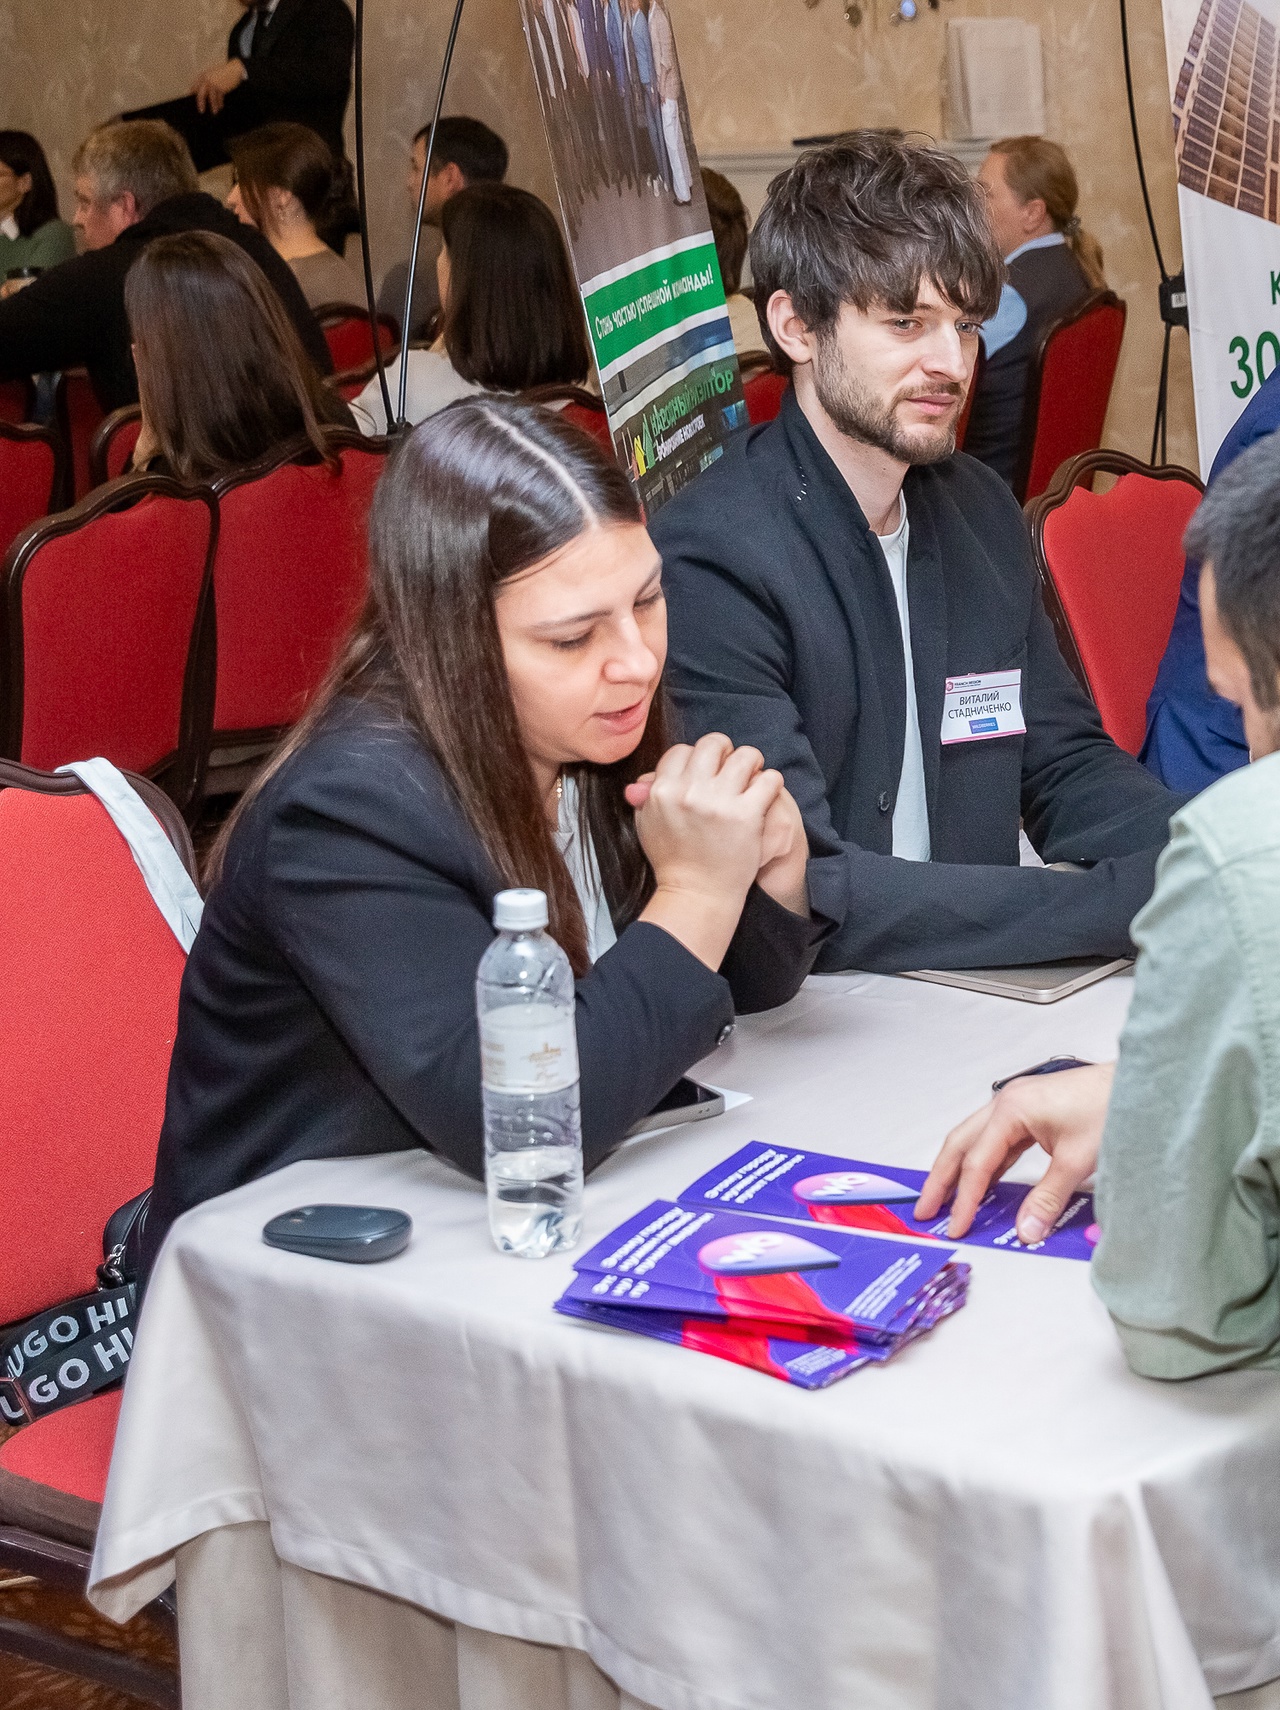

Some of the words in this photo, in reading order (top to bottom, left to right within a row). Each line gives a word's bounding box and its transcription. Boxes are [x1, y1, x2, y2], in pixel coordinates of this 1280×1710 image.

[612, 302, 637, 328] частью
[959, 690, 1000, 705] ВИТАЛИЙ
[948, 702, 1012, 719] СТАДНИЧЕНКО
[7, 1315, 80, 1377] UGO
